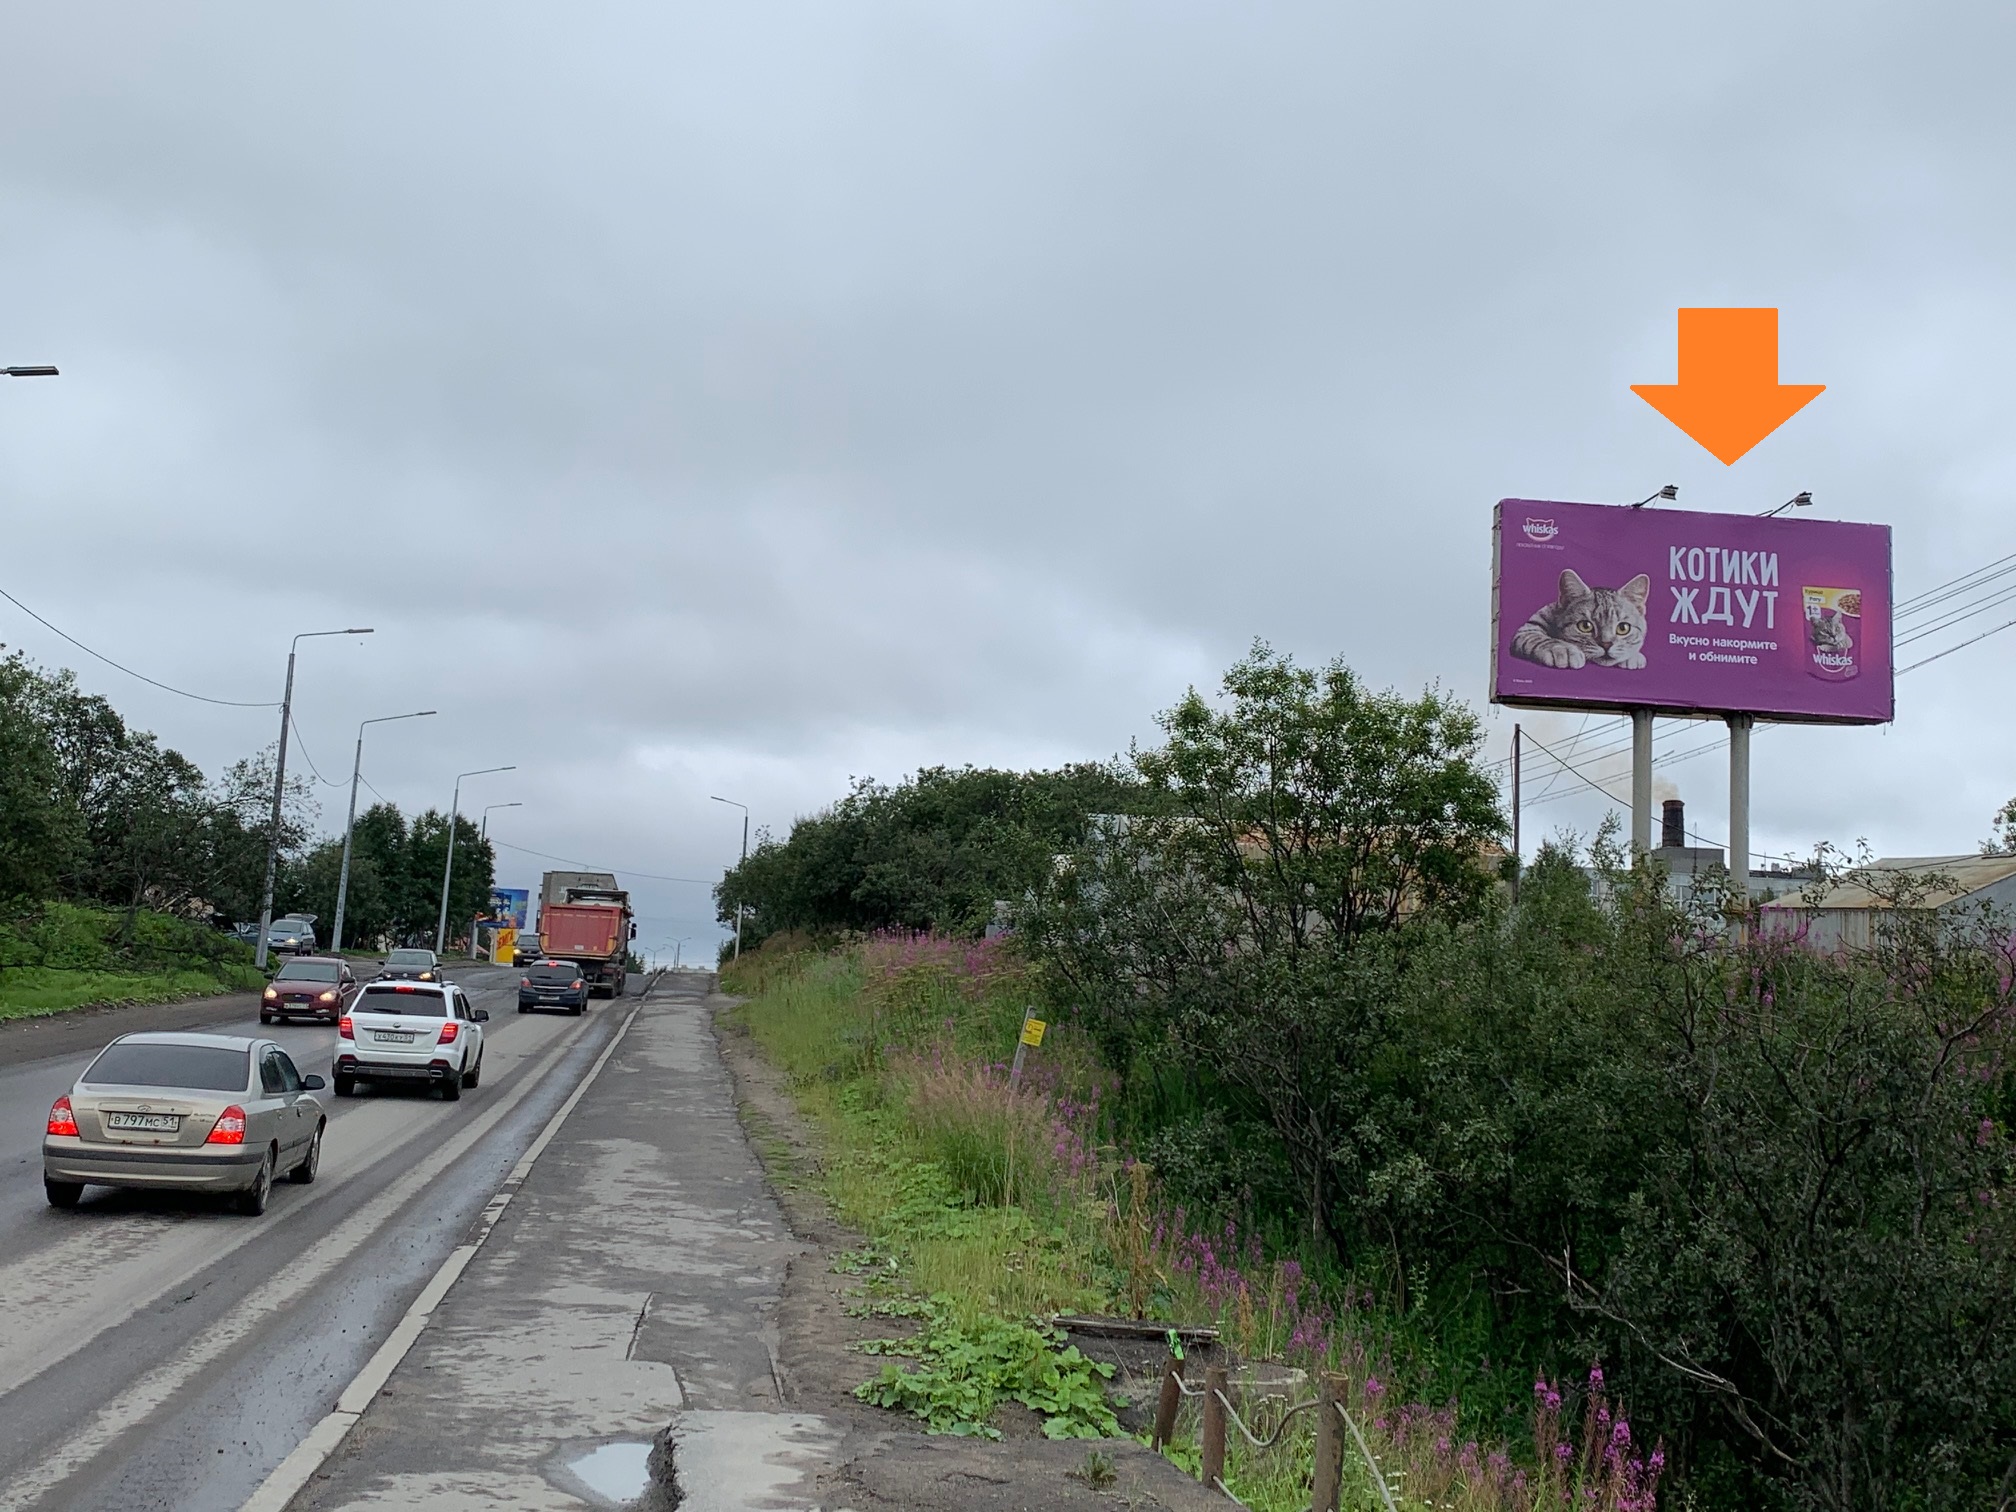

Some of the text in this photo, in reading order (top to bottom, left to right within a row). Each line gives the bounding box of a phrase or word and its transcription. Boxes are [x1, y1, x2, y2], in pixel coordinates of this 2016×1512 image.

[1522, 523, 1559, 535] whiskas
[1669, 545, 1779, 587] КОТИКИ
[1669, 586, 1779, 629] ЖДУТ
[1668, 633, 1778, 652] Вкусно накормите
[1688, 650, 1758, 665] и обнимите
[1812, 652, 1853, 666] whiskas
